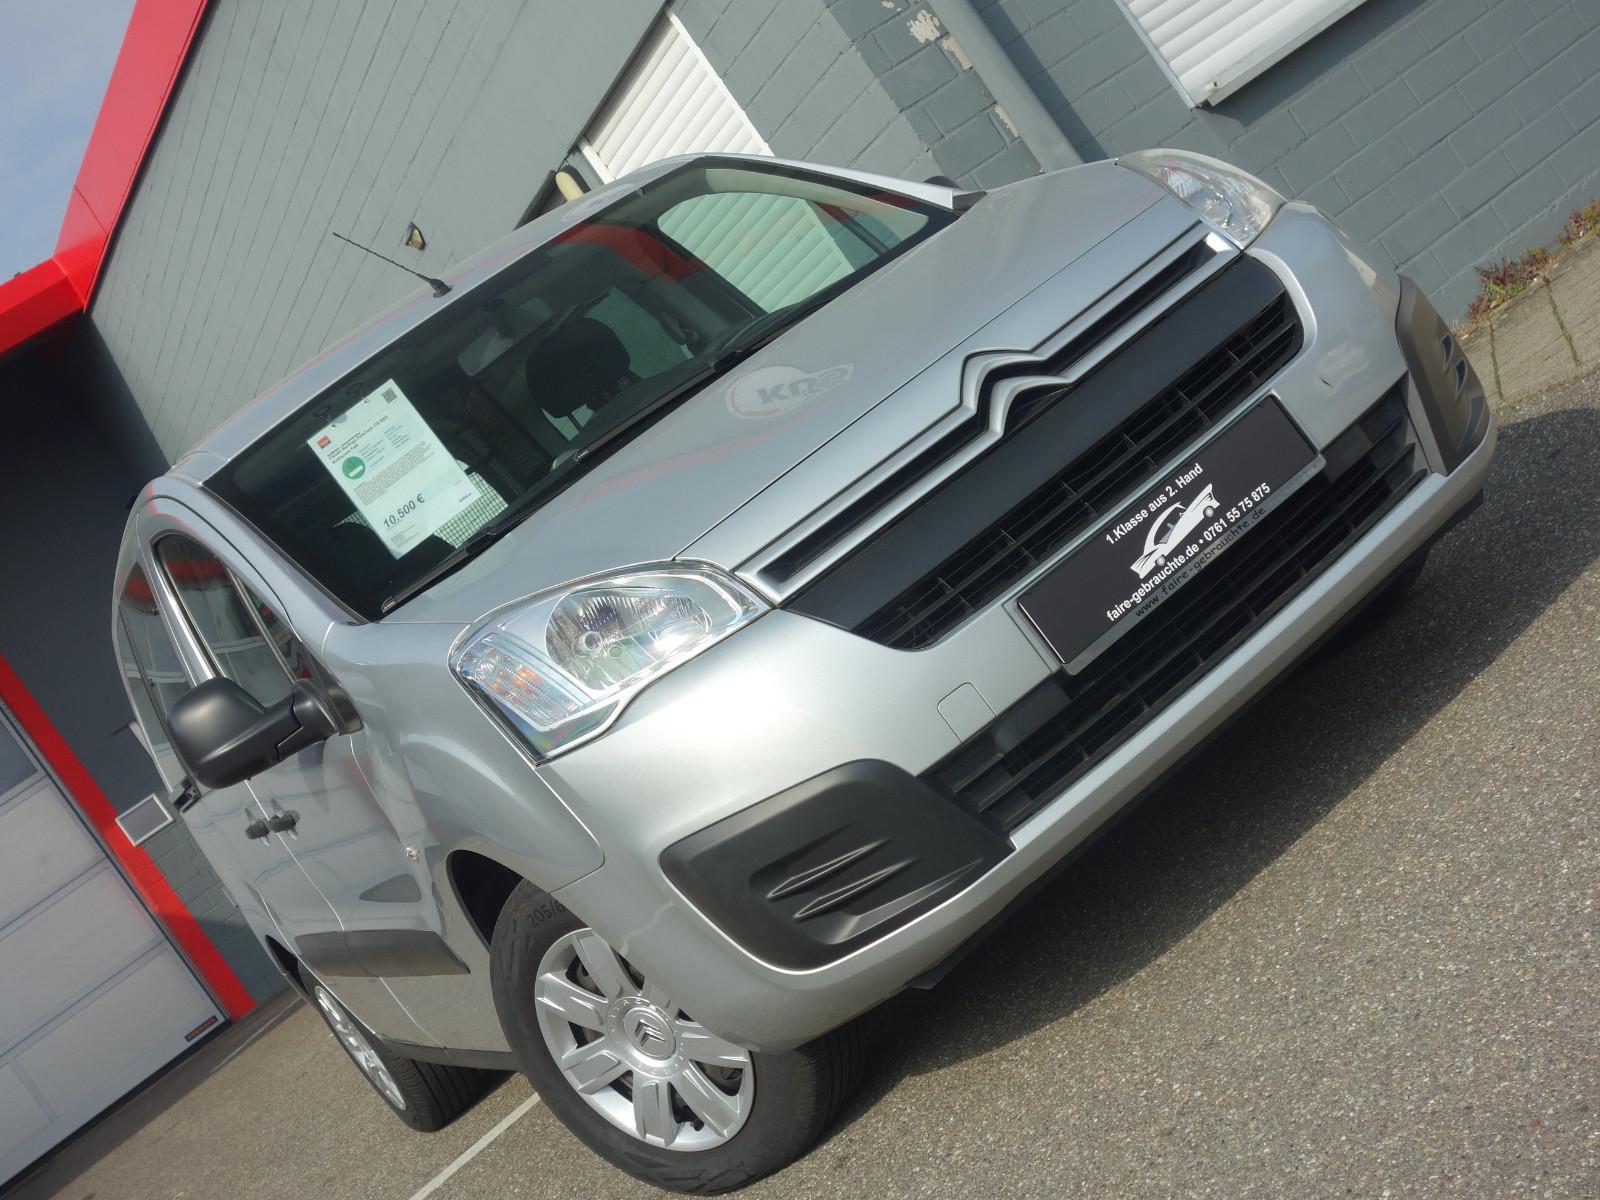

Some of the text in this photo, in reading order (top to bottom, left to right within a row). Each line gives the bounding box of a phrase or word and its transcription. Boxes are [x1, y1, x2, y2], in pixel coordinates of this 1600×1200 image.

[384, 493, 425, 528] 10.500 €
[1106, 463, 1204, 545] 1.Klasse aus 2. Hand
[1106, 482, 1271, 622] faire-gebrauchte.de 0761 55 75 875
